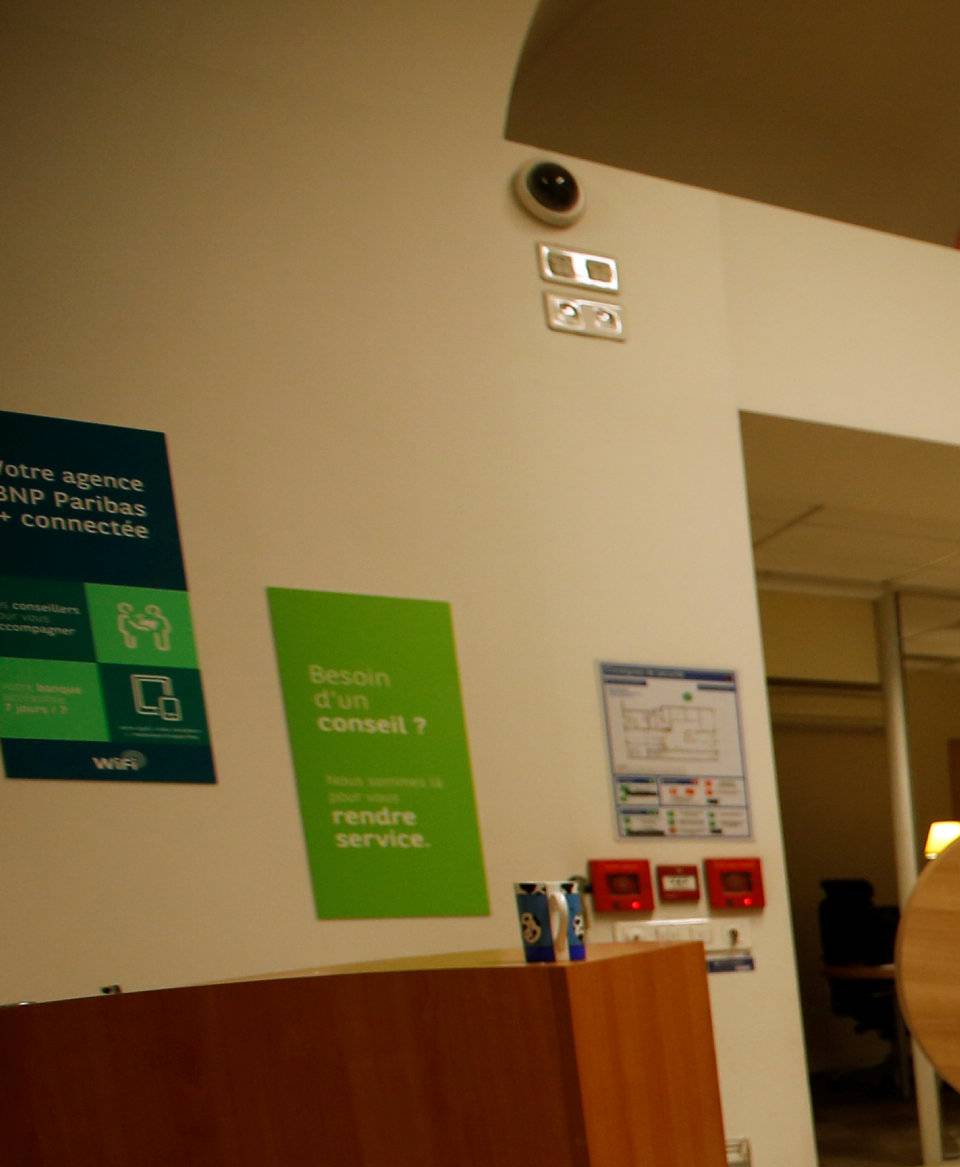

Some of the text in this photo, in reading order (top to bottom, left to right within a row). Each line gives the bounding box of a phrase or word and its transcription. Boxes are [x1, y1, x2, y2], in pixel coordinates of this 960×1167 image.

[0, 461, 145, 492] otre agence
[53, 491, 148, 518] Paribas
[20, 513, 150, 540] connectée
[307, 665, 391, 688] Besoin
[313, 690, 370, 711] d'un
[316, 715, 428, 736] conseil ?
[331, 806, 417, 826] rendre
[334, 829, 432, 849] service.
